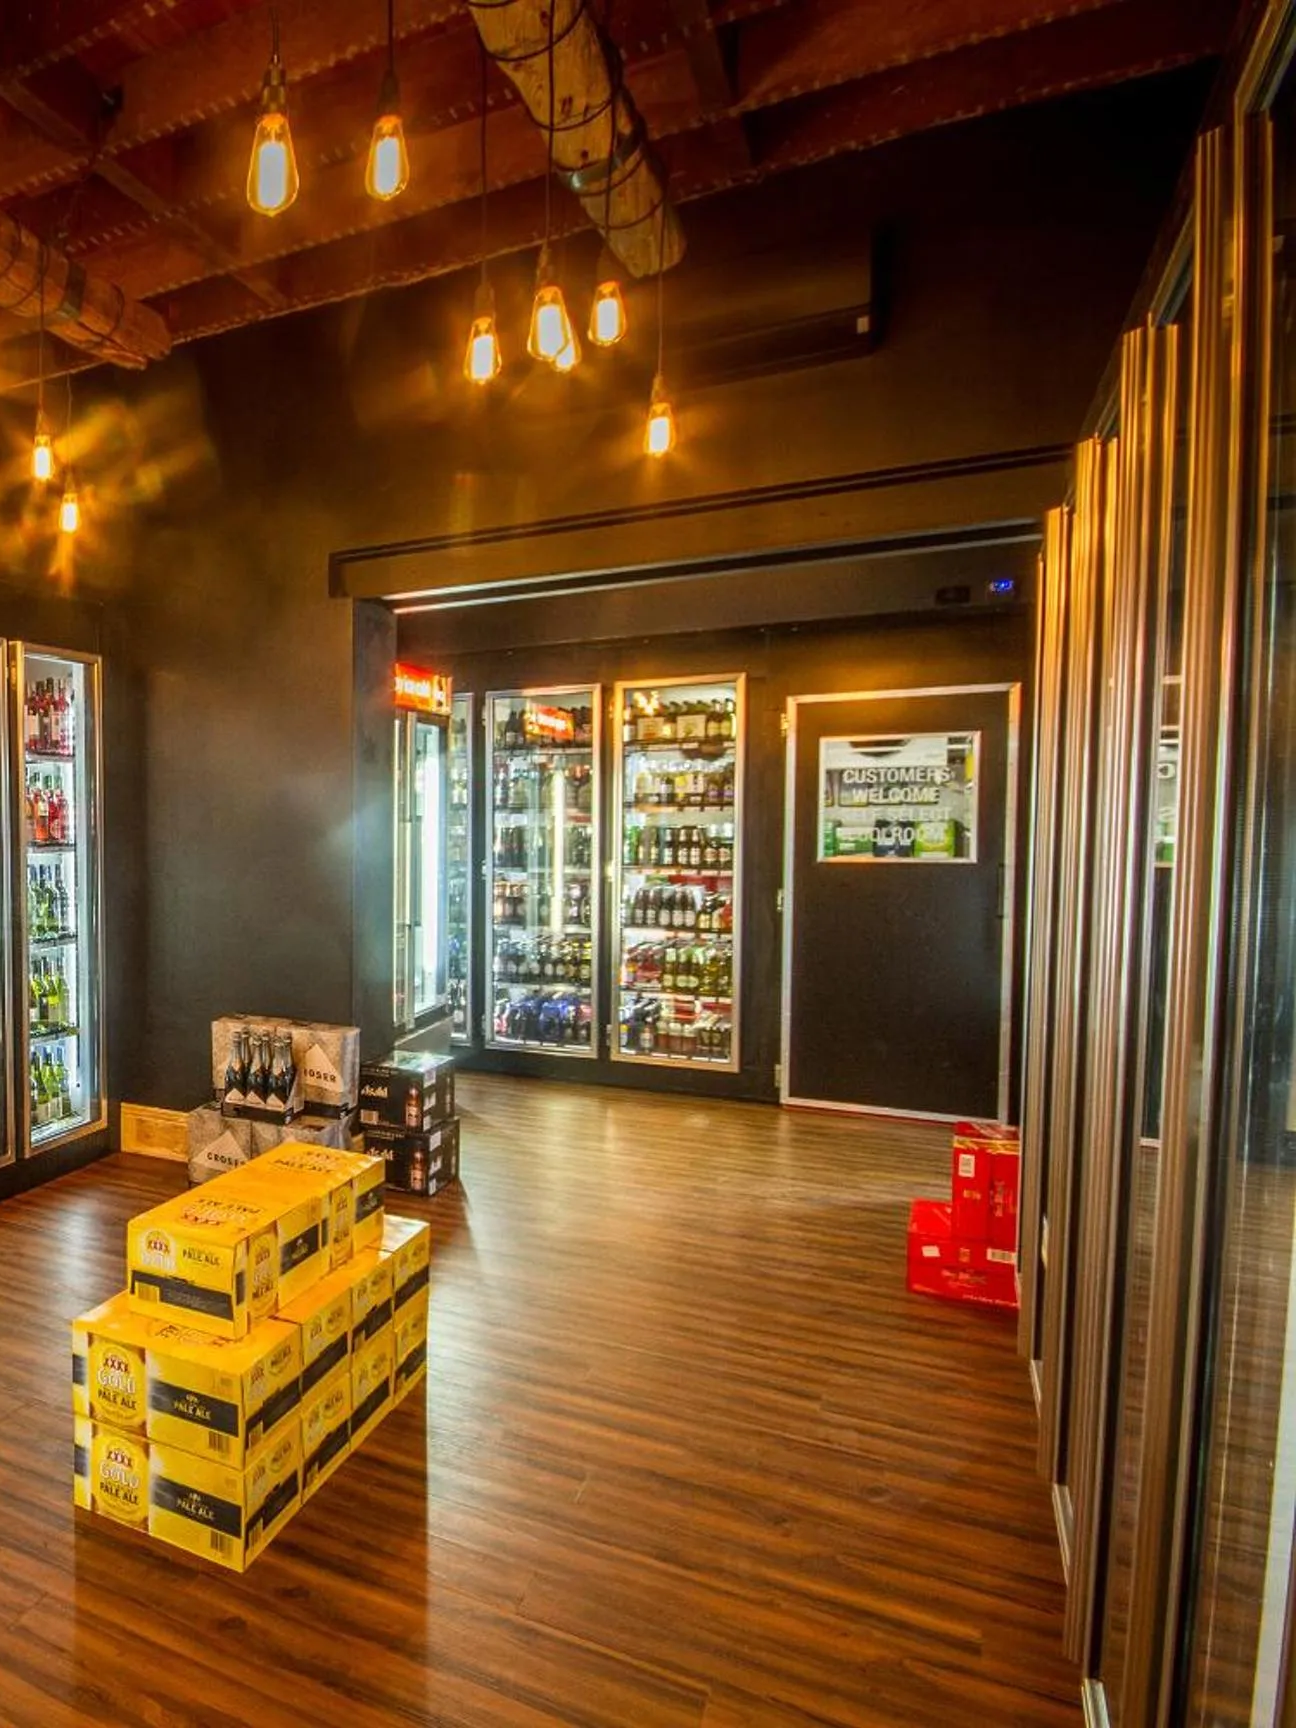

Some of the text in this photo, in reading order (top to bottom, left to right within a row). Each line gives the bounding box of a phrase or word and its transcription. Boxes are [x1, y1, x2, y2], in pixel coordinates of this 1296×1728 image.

[842, 767, 951, 784] CUSTOMERS
[852, 786, 941, 804] WELCOME
[303, 1068, 337, 1083] OSER
[182, 1248, 221, 1267] PALE ALE
[104, 1354, 129, 1373] XXXX
[97, 1366, 136, 1395] GOLD
[98, 1389, 137, 1411] PALE ALE
[174, 1400, 211, 1421] PALE ALE
[106, 1449, 132, 1469] XXXX
[99, 1461, 139, 1489] GOLD
[100, 1481, 139, 1505] PALE ALE
[177, 1499, 215, 1521] PALE ALE
